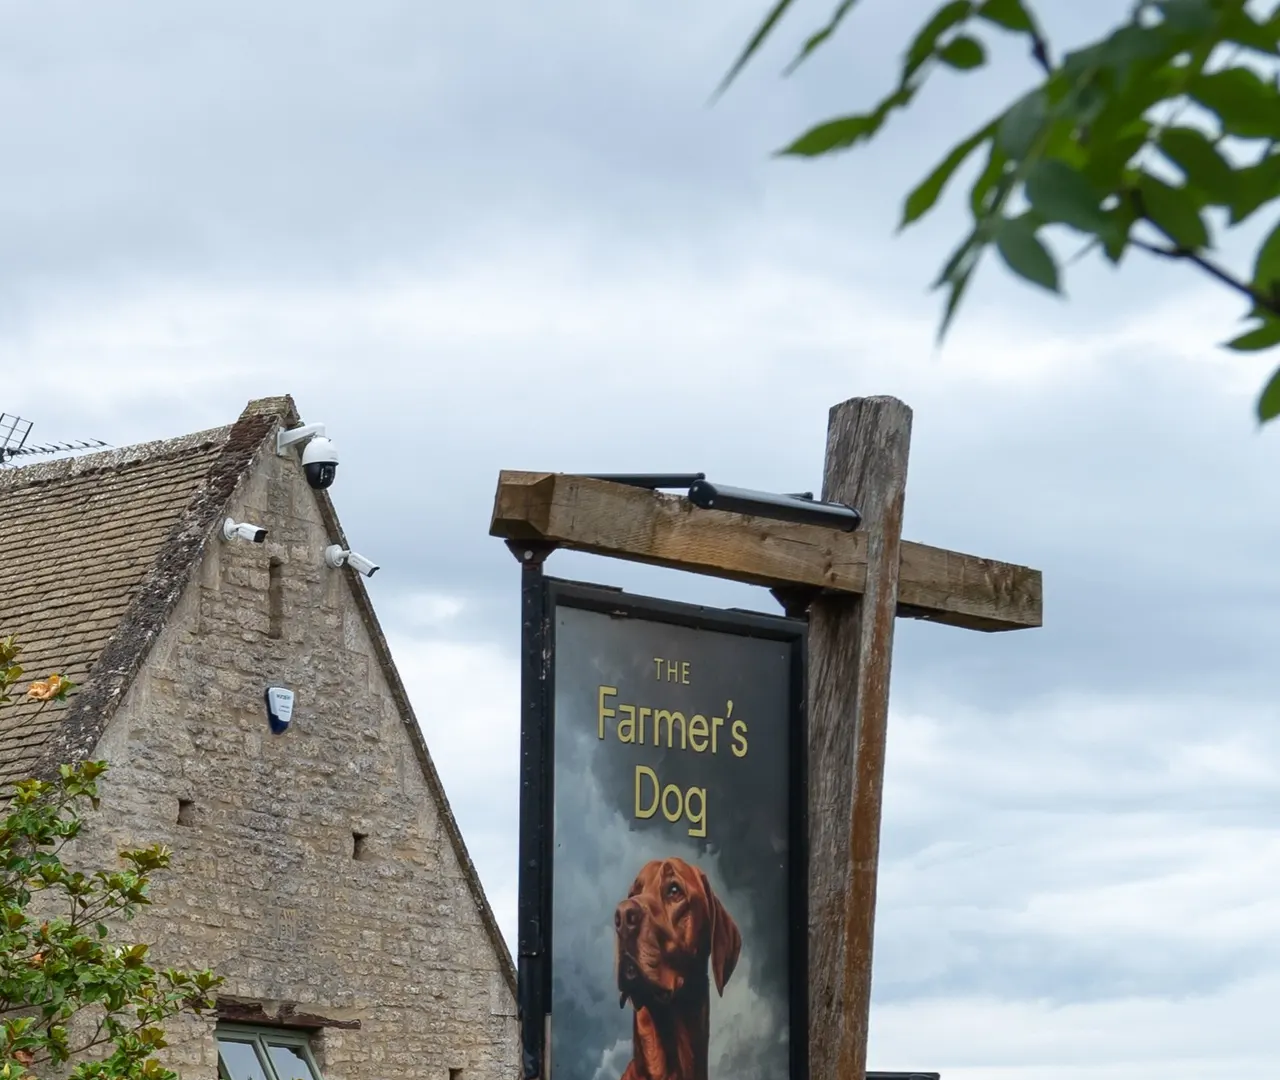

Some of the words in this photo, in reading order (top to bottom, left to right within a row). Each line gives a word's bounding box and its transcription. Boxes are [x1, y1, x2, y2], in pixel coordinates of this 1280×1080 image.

[653, 657, 691, 685] THE
[597, 685, 749, 758] Farmer's
[634, 765, 707, 838] Dog
